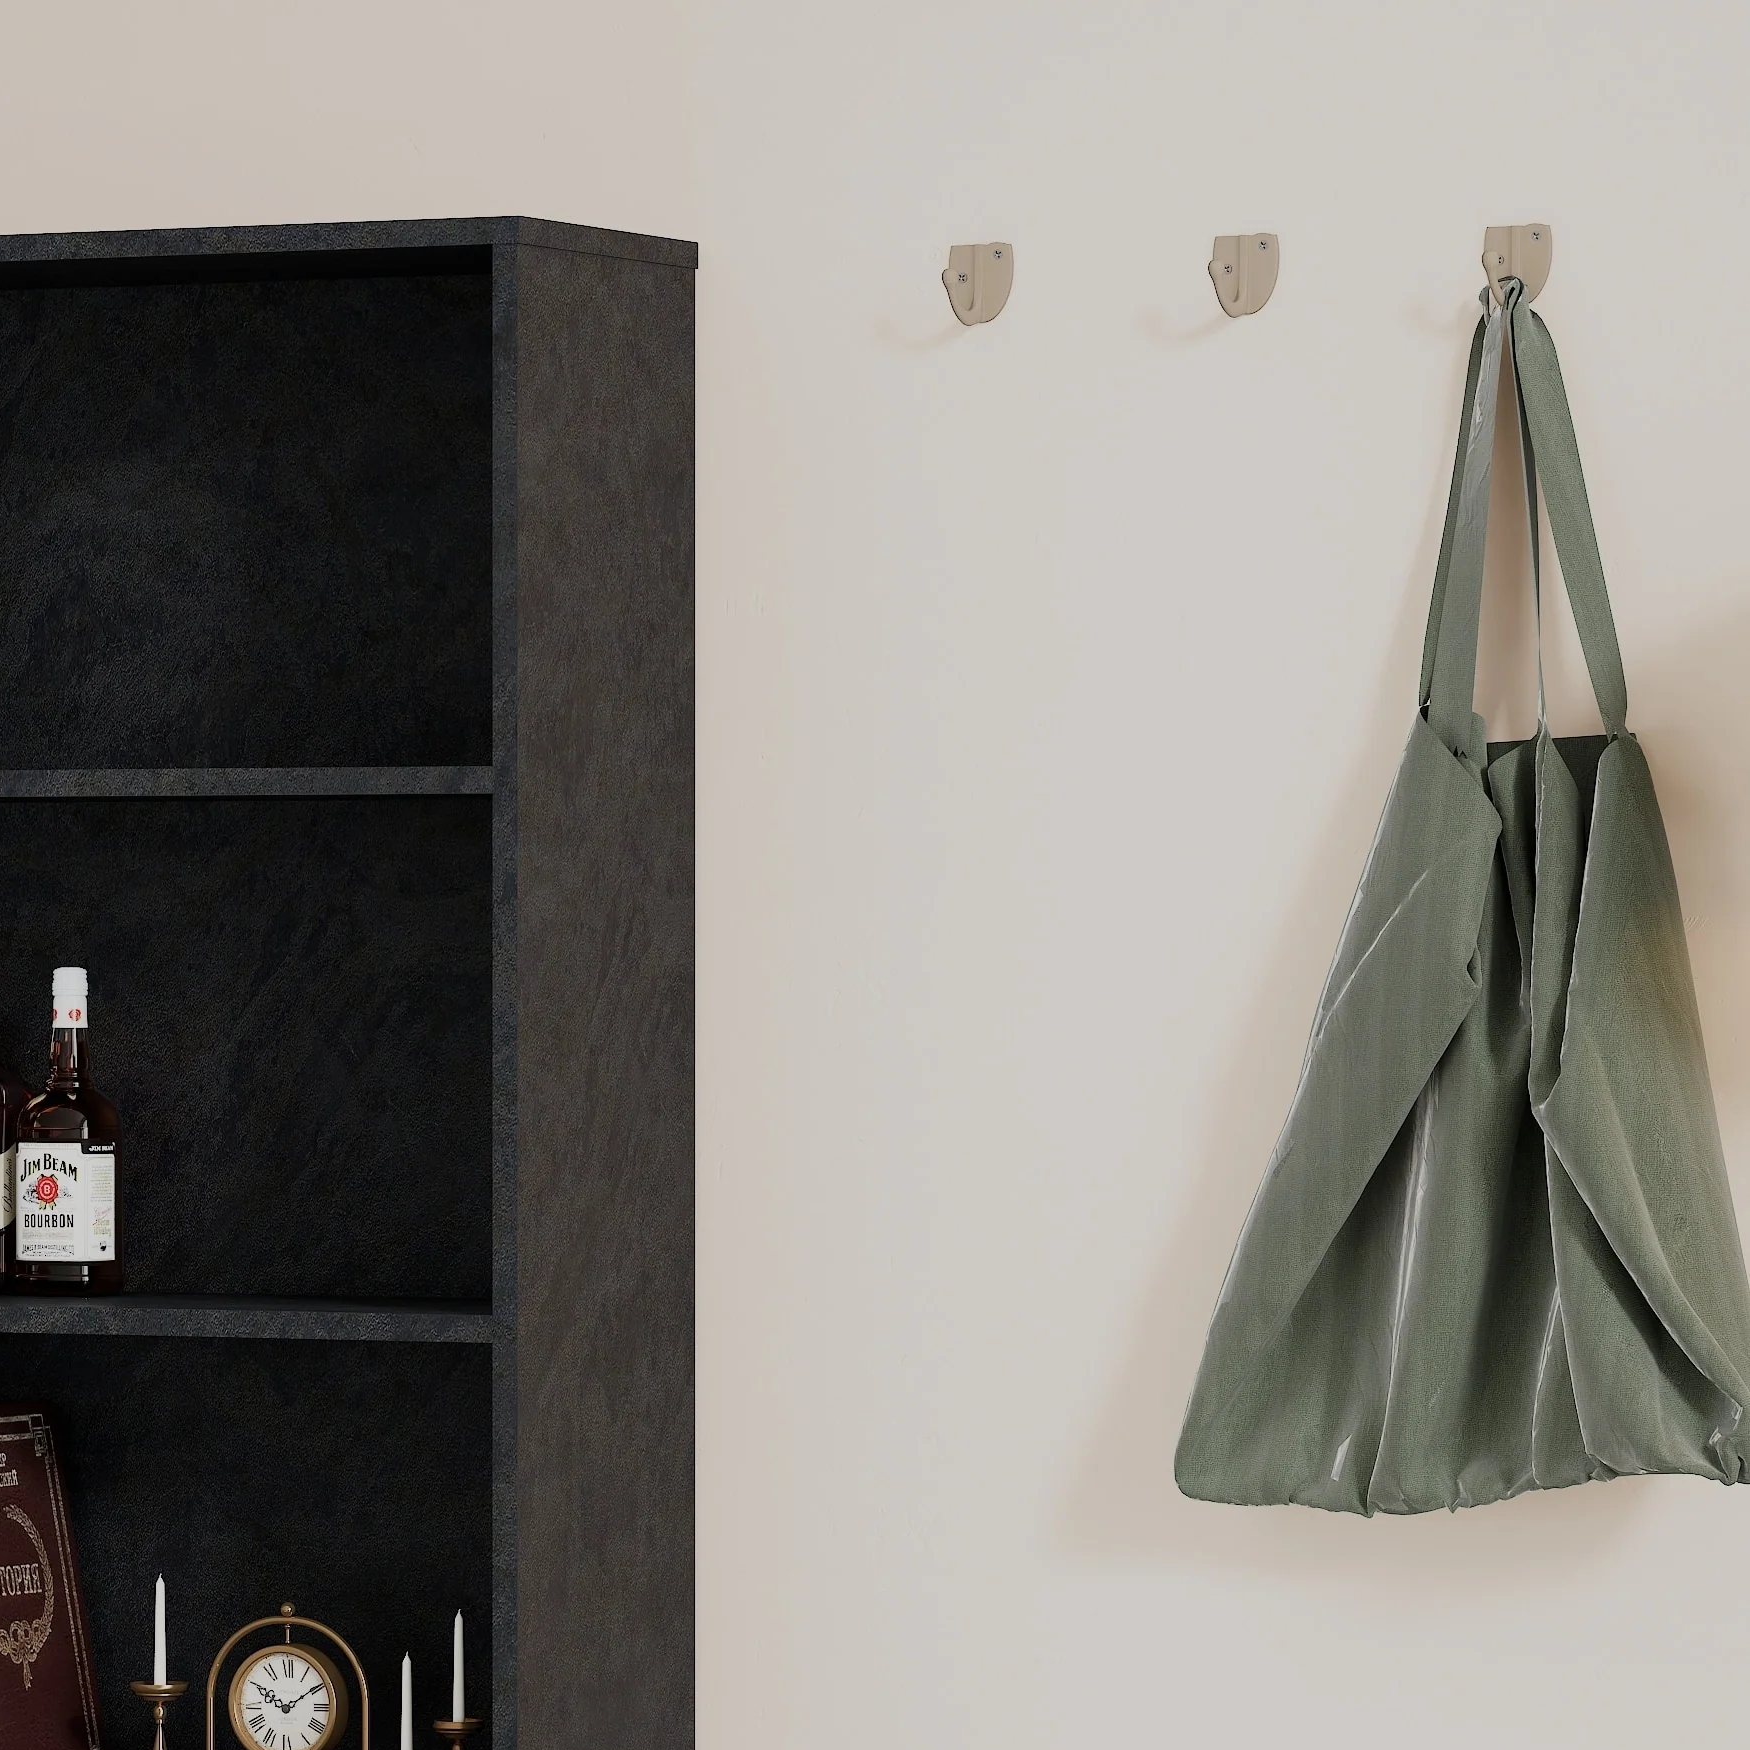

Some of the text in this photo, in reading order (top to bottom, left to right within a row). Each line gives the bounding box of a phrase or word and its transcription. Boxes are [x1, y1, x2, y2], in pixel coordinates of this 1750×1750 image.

[20, 1153, 78, 1182] JIM BEAM
[24, 1213, 74, 1228] BOURBON
